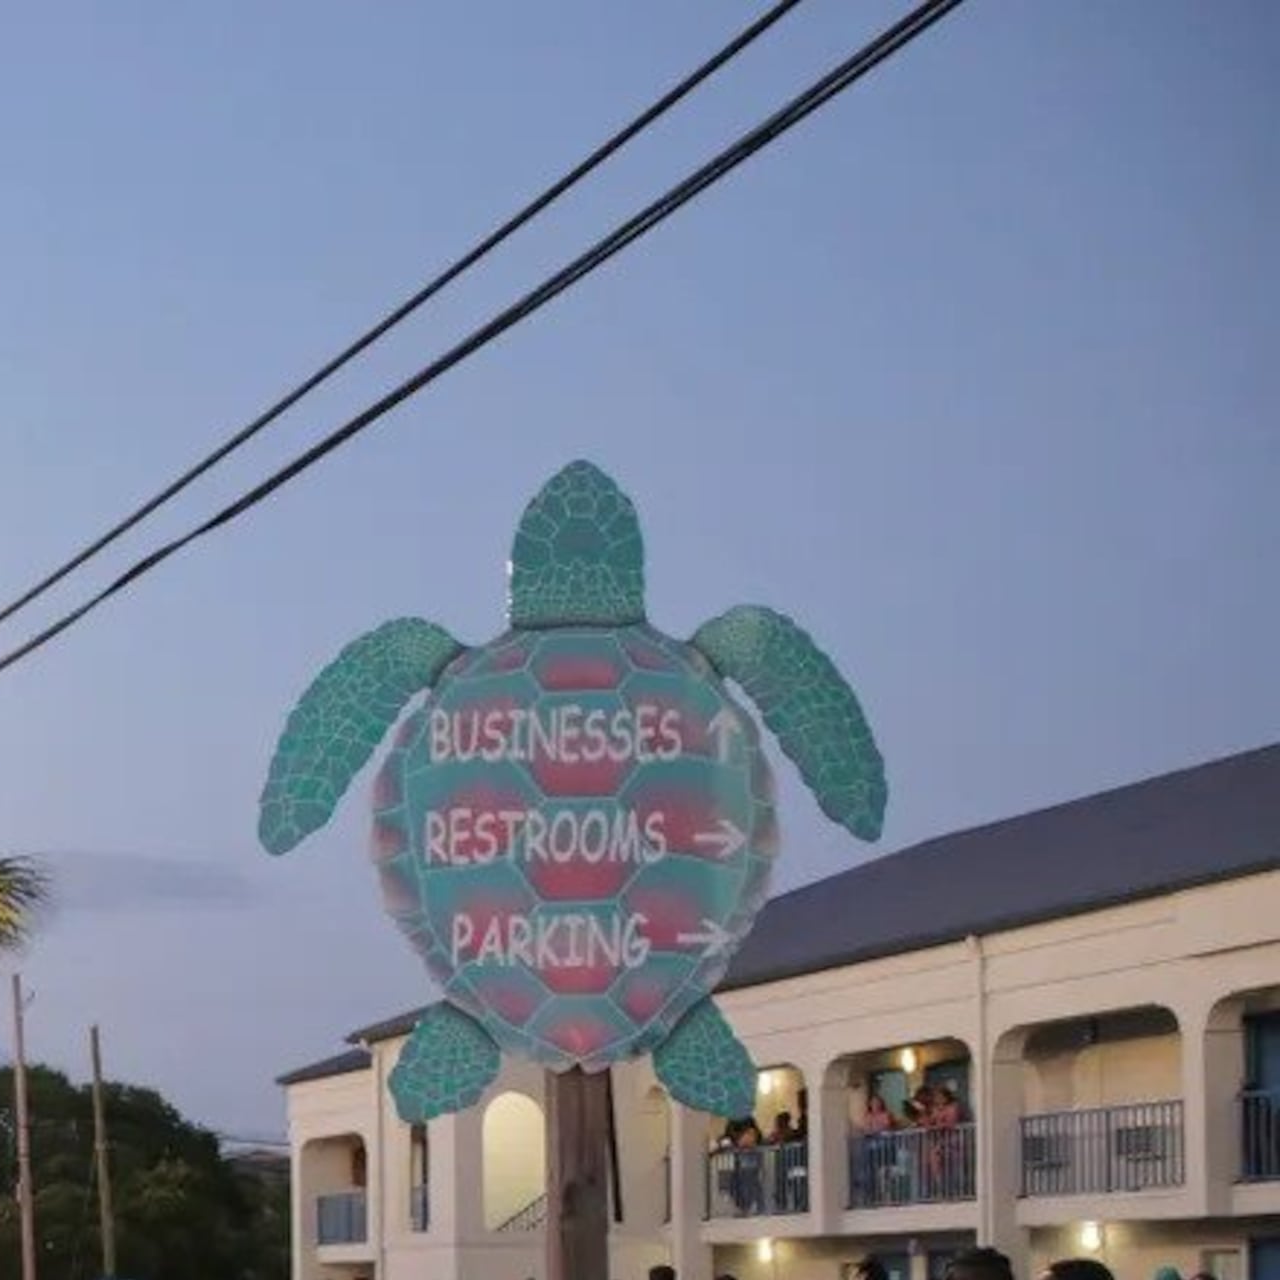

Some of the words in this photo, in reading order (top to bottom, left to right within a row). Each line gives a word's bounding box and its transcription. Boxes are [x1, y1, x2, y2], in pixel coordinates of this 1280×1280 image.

[430, 704, 682, 762] BUSINESSES
[424, 806, 667, 864] RESTROOMS
[451, 913, 651, 967] PARKING
